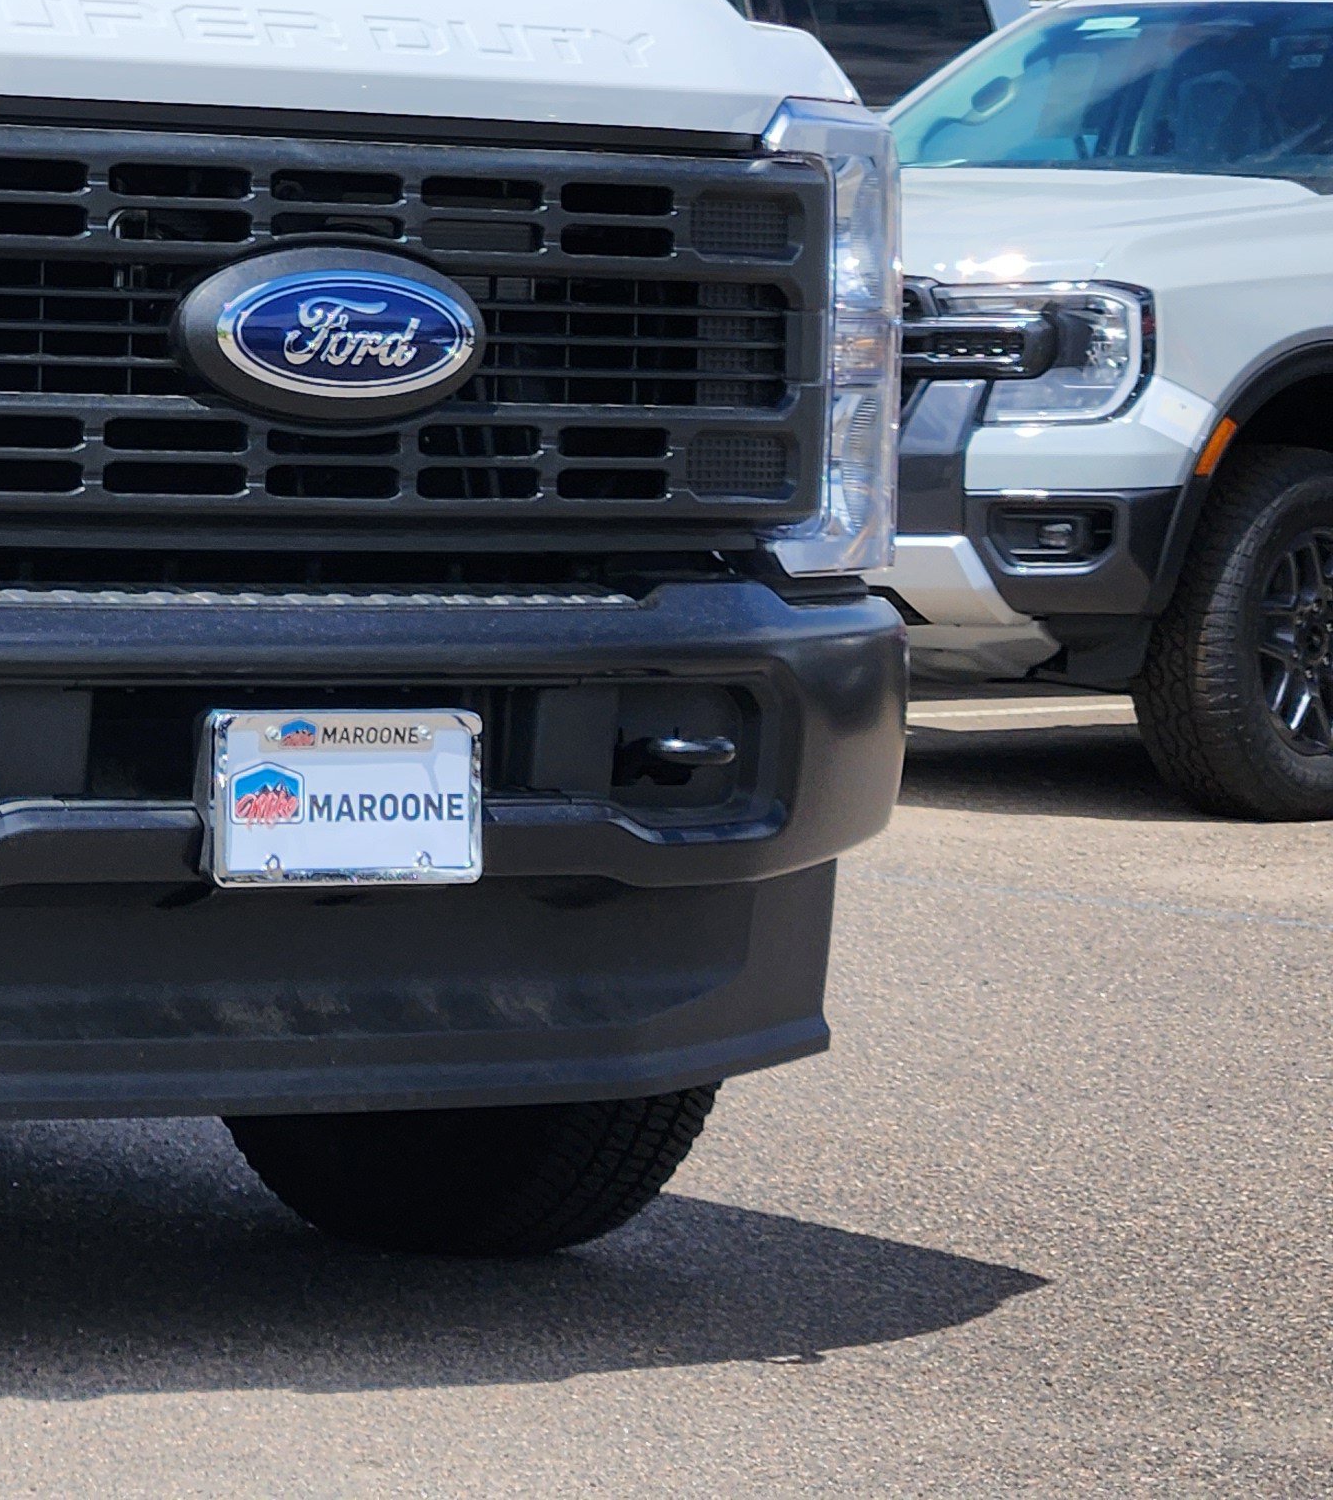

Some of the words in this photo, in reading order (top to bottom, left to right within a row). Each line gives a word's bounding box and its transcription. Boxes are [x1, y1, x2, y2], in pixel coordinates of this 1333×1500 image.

[363, 15, 657, 68] DUTY
[284, 296, 421, 367] Ford
[321, 726, 420, 745] MAROONE
[308, 792, 464, 822] MAROONE
